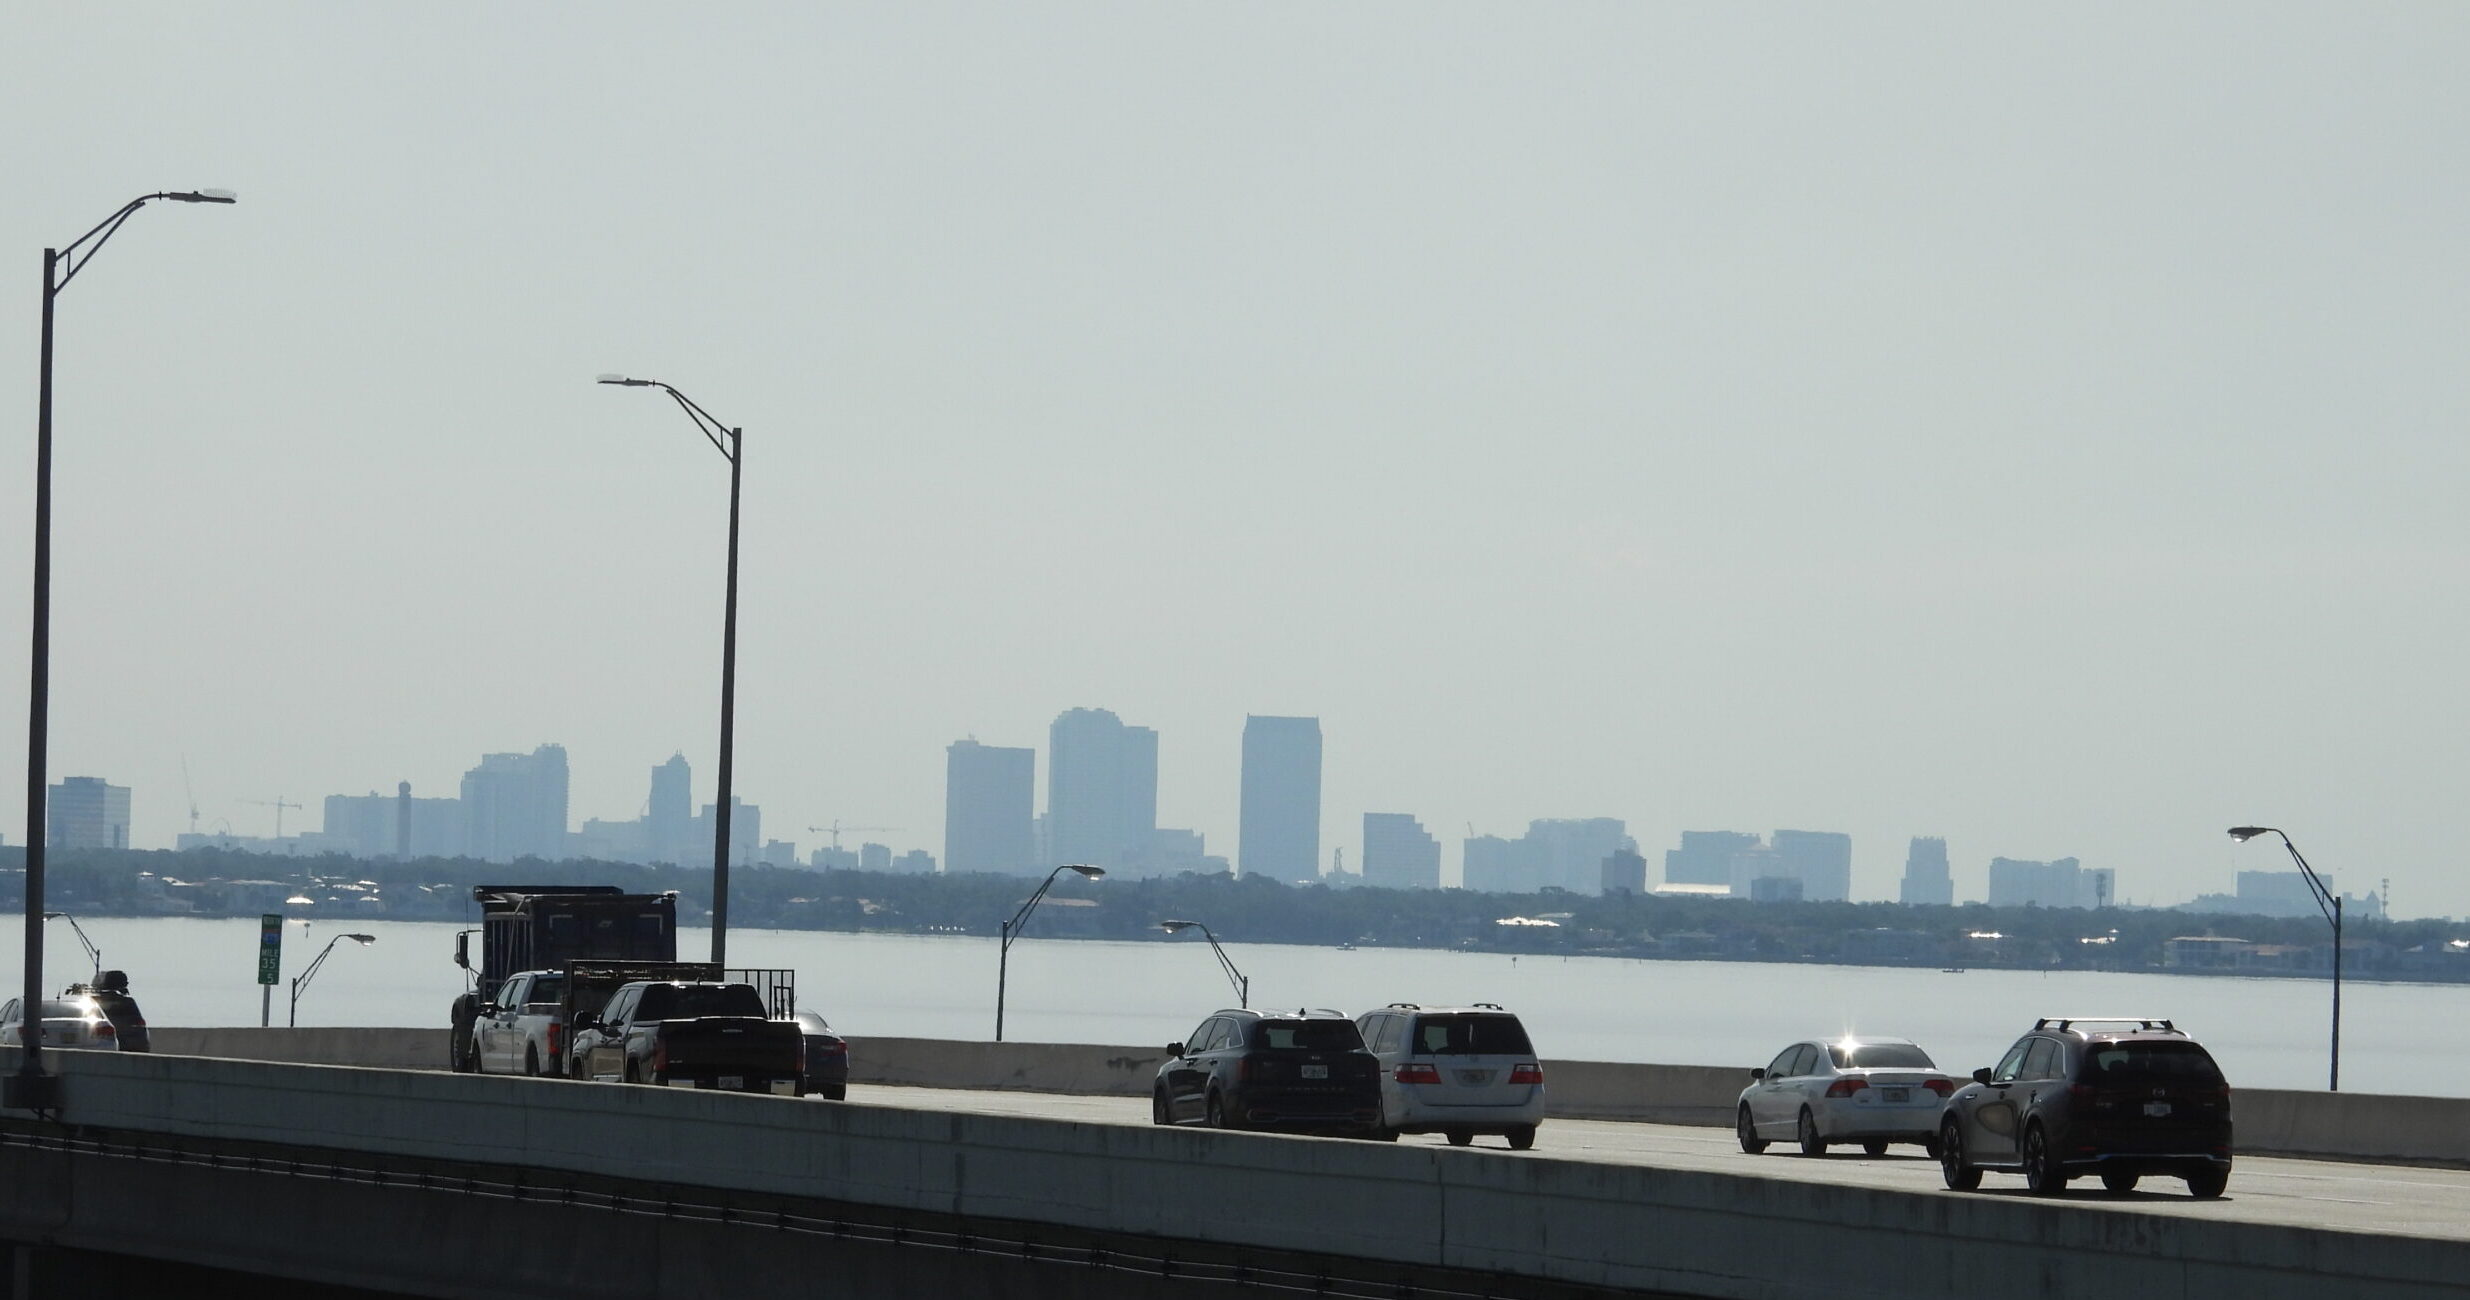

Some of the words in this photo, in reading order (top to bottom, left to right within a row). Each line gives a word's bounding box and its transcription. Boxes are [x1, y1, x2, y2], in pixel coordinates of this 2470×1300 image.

[261, 948, 279, 957] MILE
[262, 958, 276, 969] 35
[267, 973, 274, 984] 5
